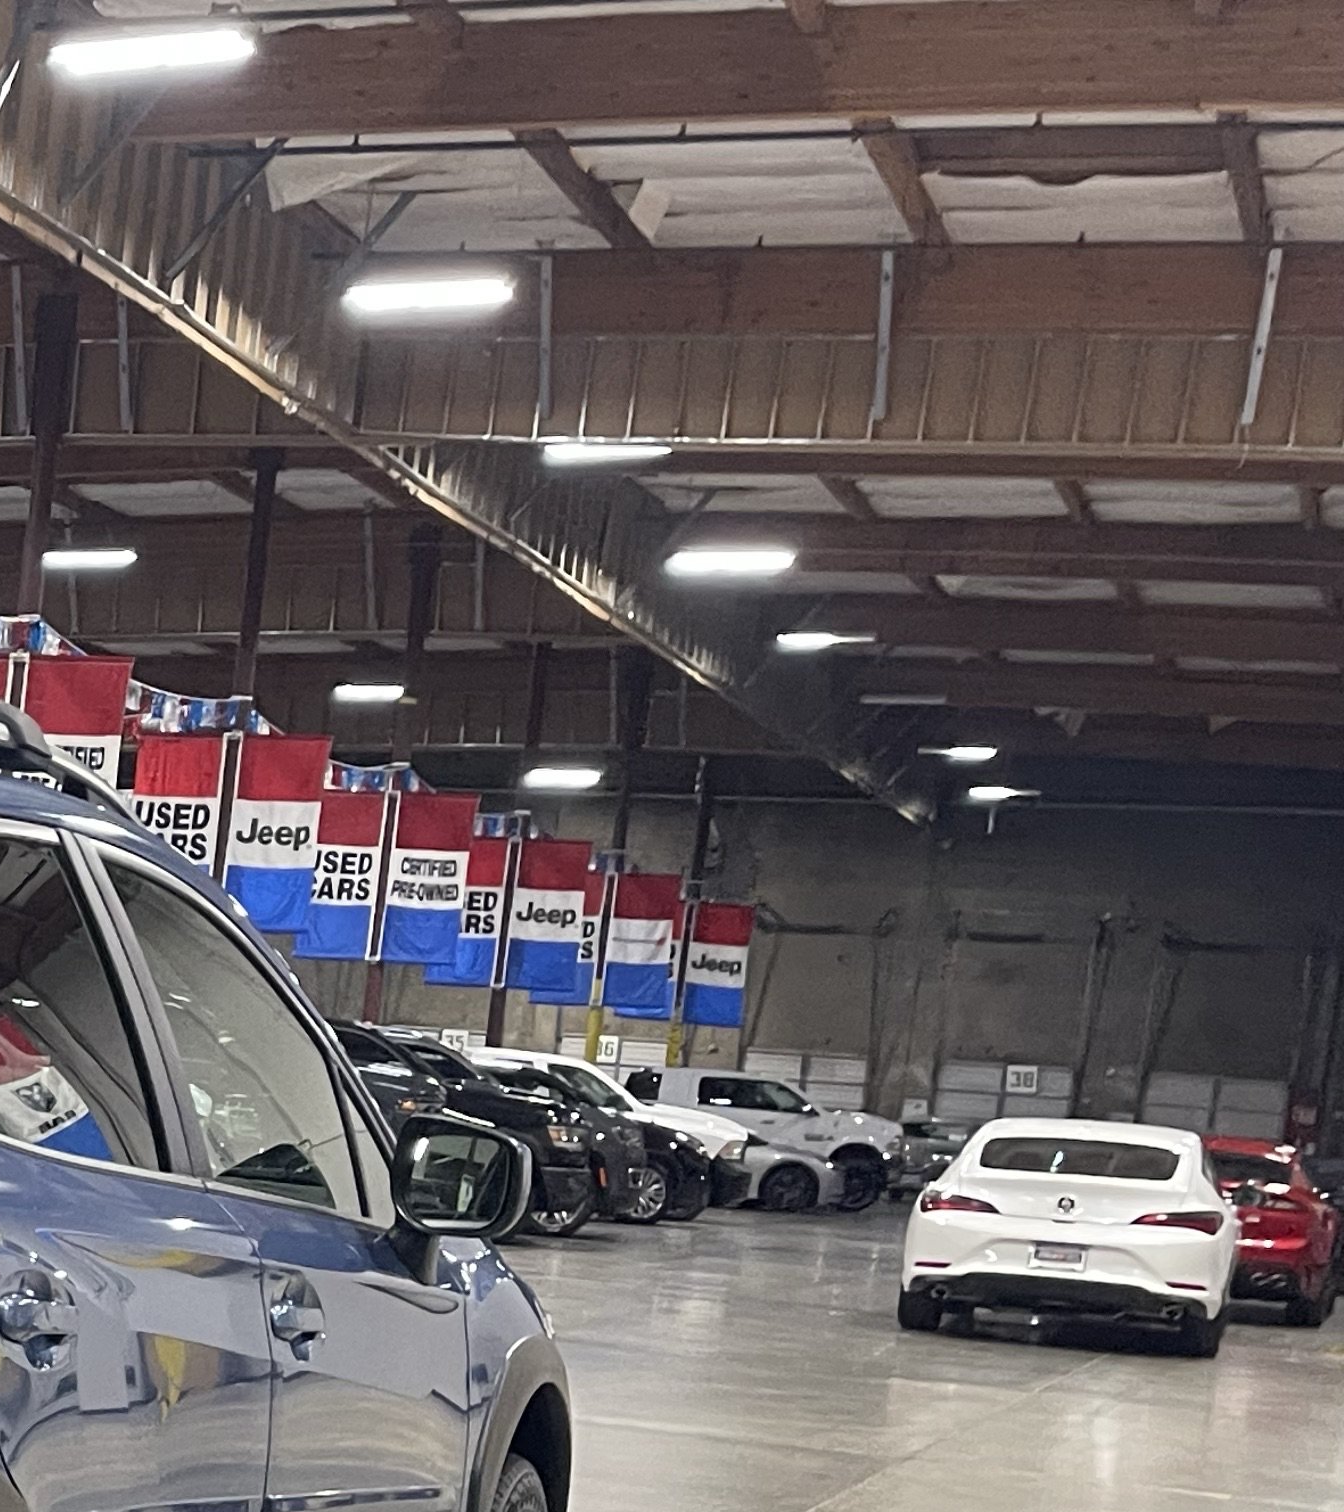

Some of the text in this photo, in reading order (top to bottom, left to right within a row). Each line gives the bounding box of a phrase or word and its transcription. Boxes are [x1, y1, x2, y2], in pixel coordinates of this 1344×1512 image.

[136, 801, 210, 830] USED
[236, 818, 310, 851] Jeep
[310, 877, 371, 901] ARS
[464, 891, 498, 911] ED
[464, 914, 495, 934] RS
[516, 901, 577, 929] Jeep
[691, 953, 742, 976] Jeep
